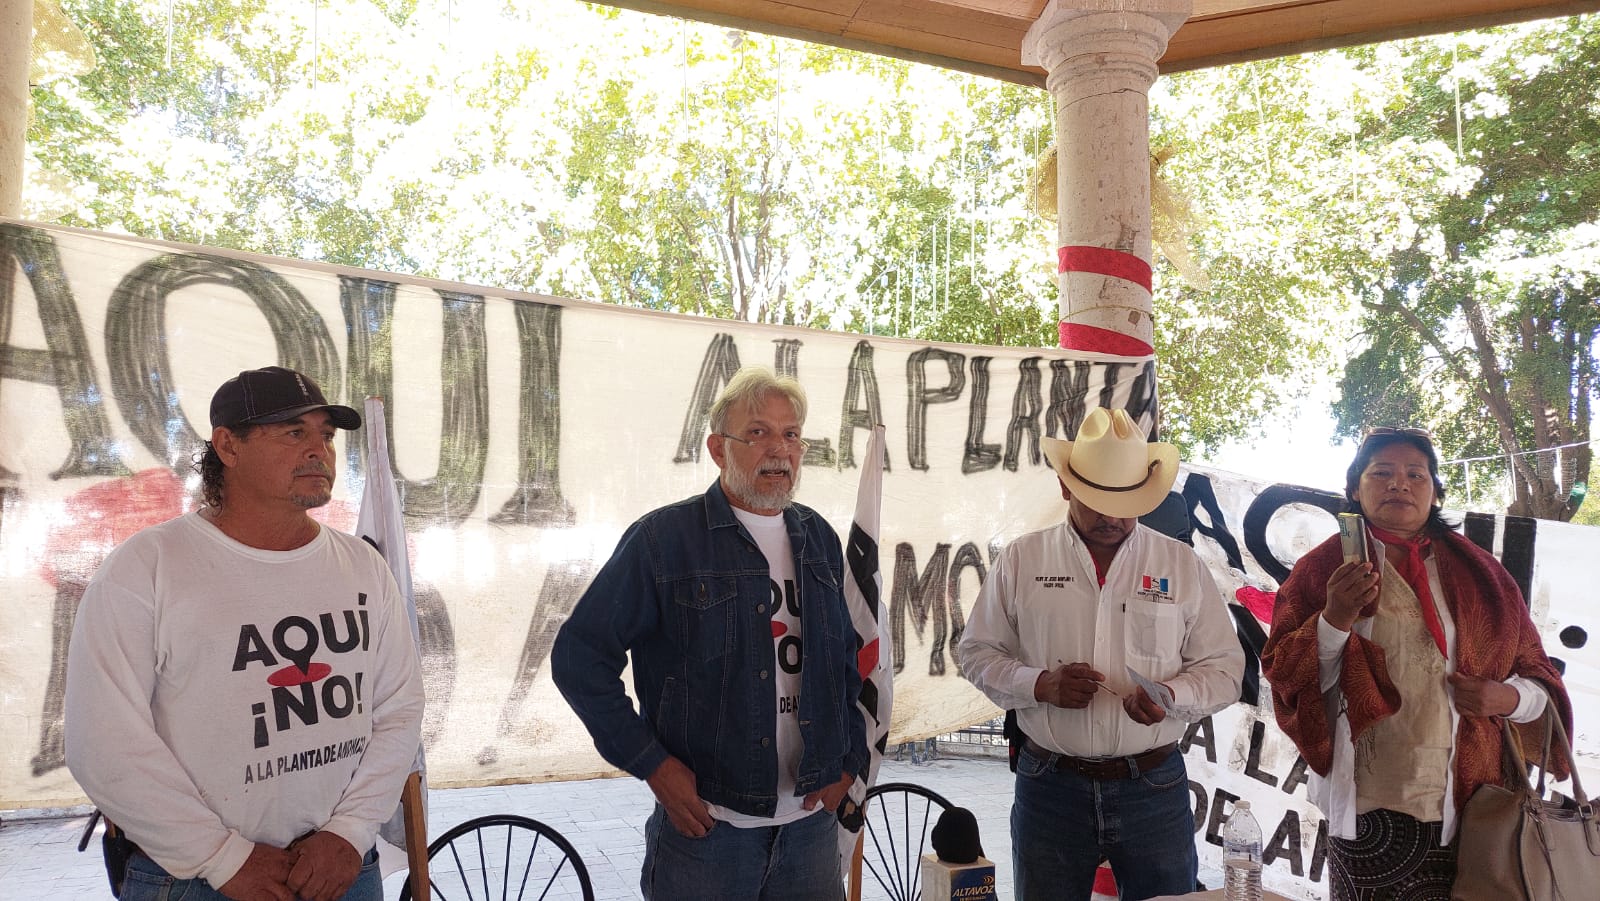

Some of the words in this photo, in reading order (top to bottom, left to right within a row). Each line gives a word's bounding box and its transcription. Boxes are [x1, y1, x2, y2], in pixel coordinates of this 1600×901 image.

[251, 672, 363, 749] ¡NO!
[257, 759, 274, 782] LA
[952, 885, 995, 898] ALTAVOZ
